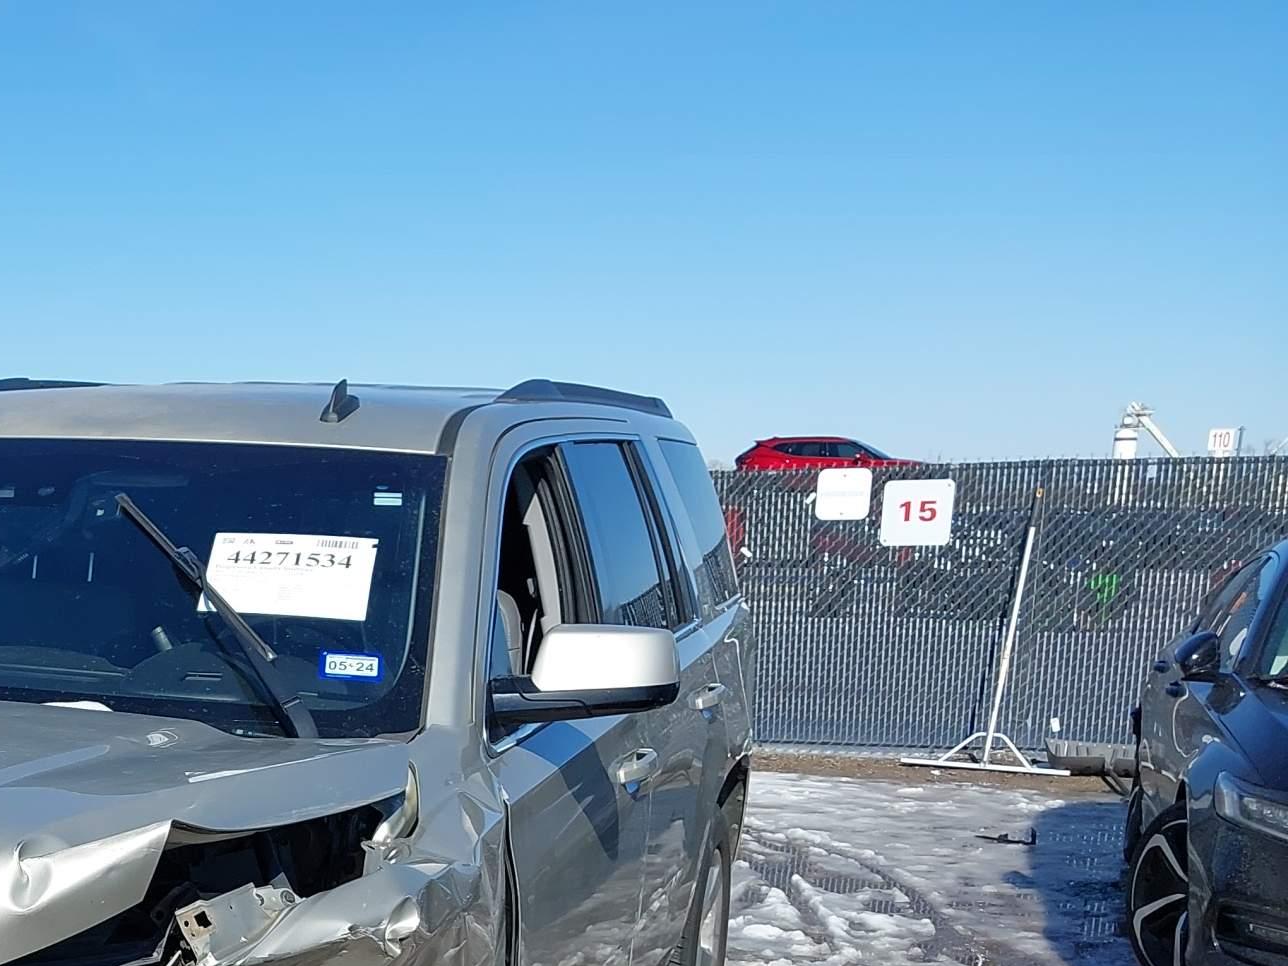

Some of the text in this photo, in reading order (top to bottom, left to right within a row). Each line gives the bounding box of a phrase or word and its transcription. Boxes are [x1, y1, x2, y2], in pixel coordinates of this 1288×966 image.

[1213, 431, 1231, 449] 110
[899, 500, 937, 522] 15
[226, 549, 353, 569] 44271534
